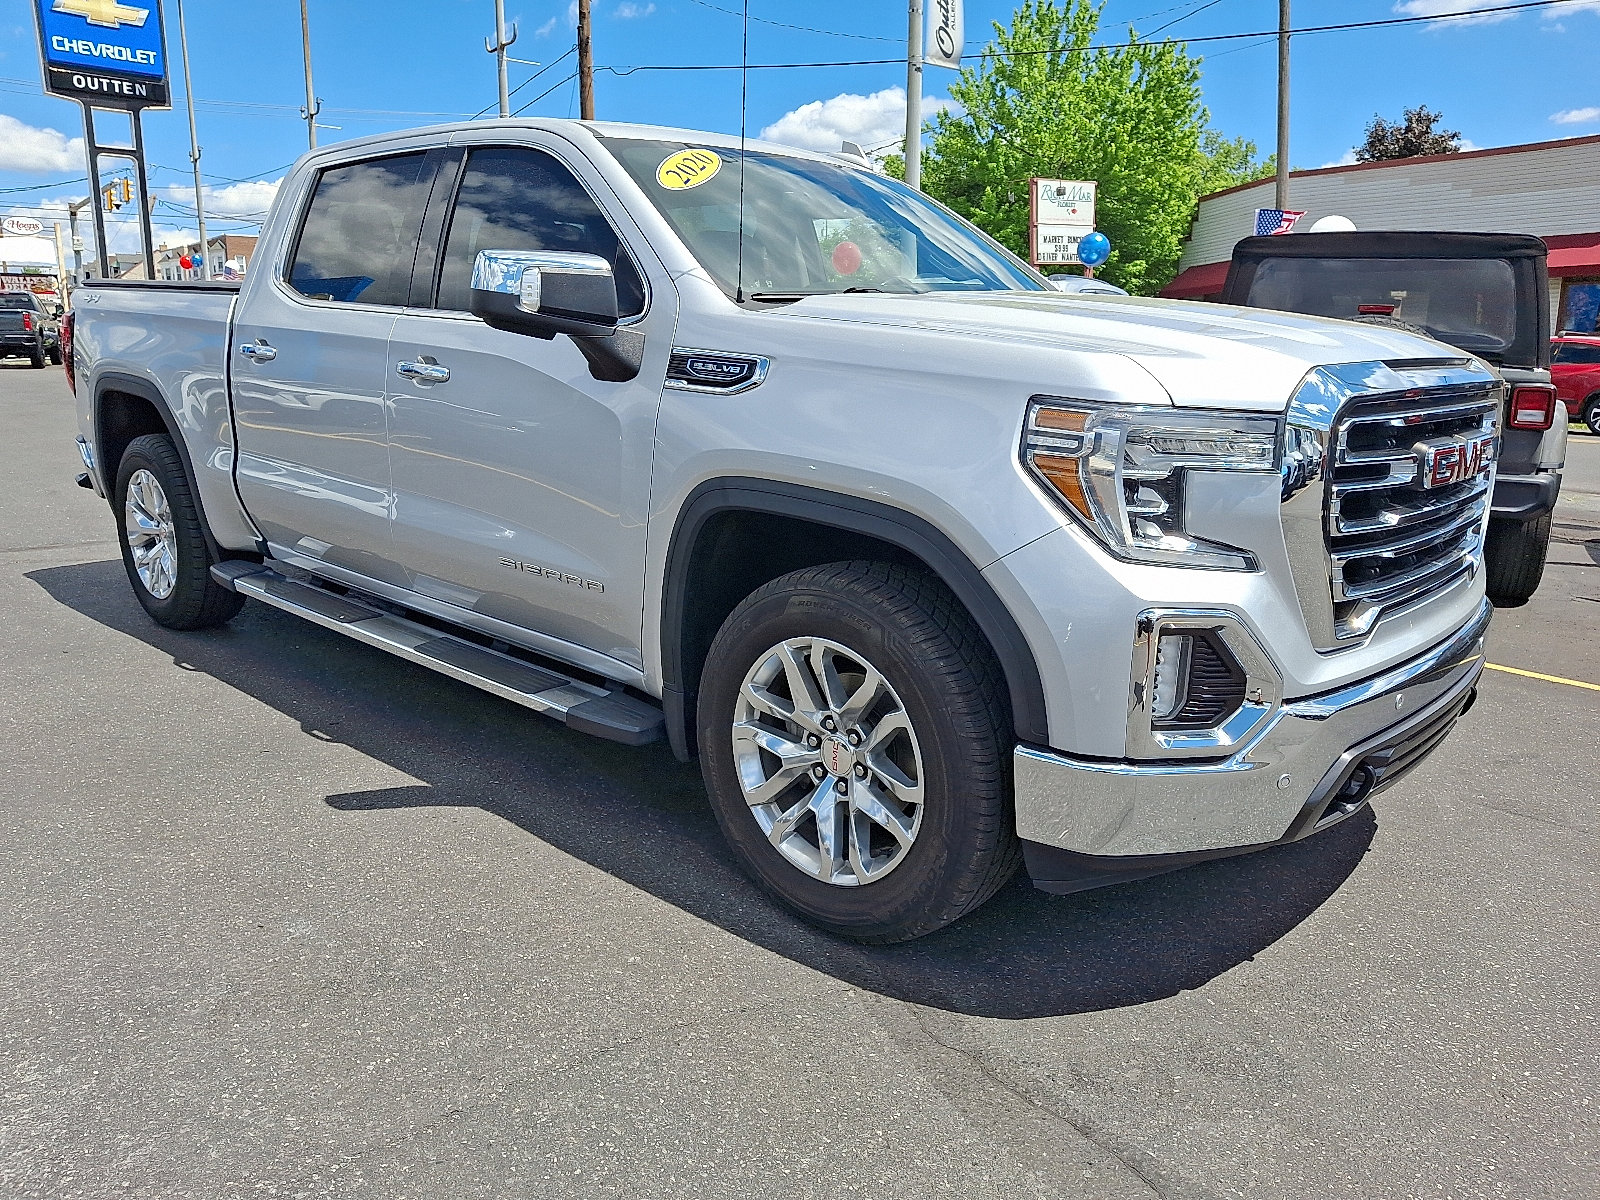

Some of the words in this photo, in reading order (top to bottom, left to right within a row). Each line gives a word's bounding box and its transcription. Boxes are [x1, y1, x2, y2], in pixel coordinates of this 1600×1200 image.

[51, 35, 157, 65] CHEVROLET
[72, 74, 148, 97] OUTTEN
[665, 151, 714, 186] 2020
[1067, 185, 1092, 201] MAR
[1043, 236, 1064, 244] MARKET
[1037, 253, 1058, 262] DRIVER
[1061, 253, 1081, 262] WANTE
[1431, 439, 1492, 487] GMC
[498, 556, 605, 593] SIERRA
